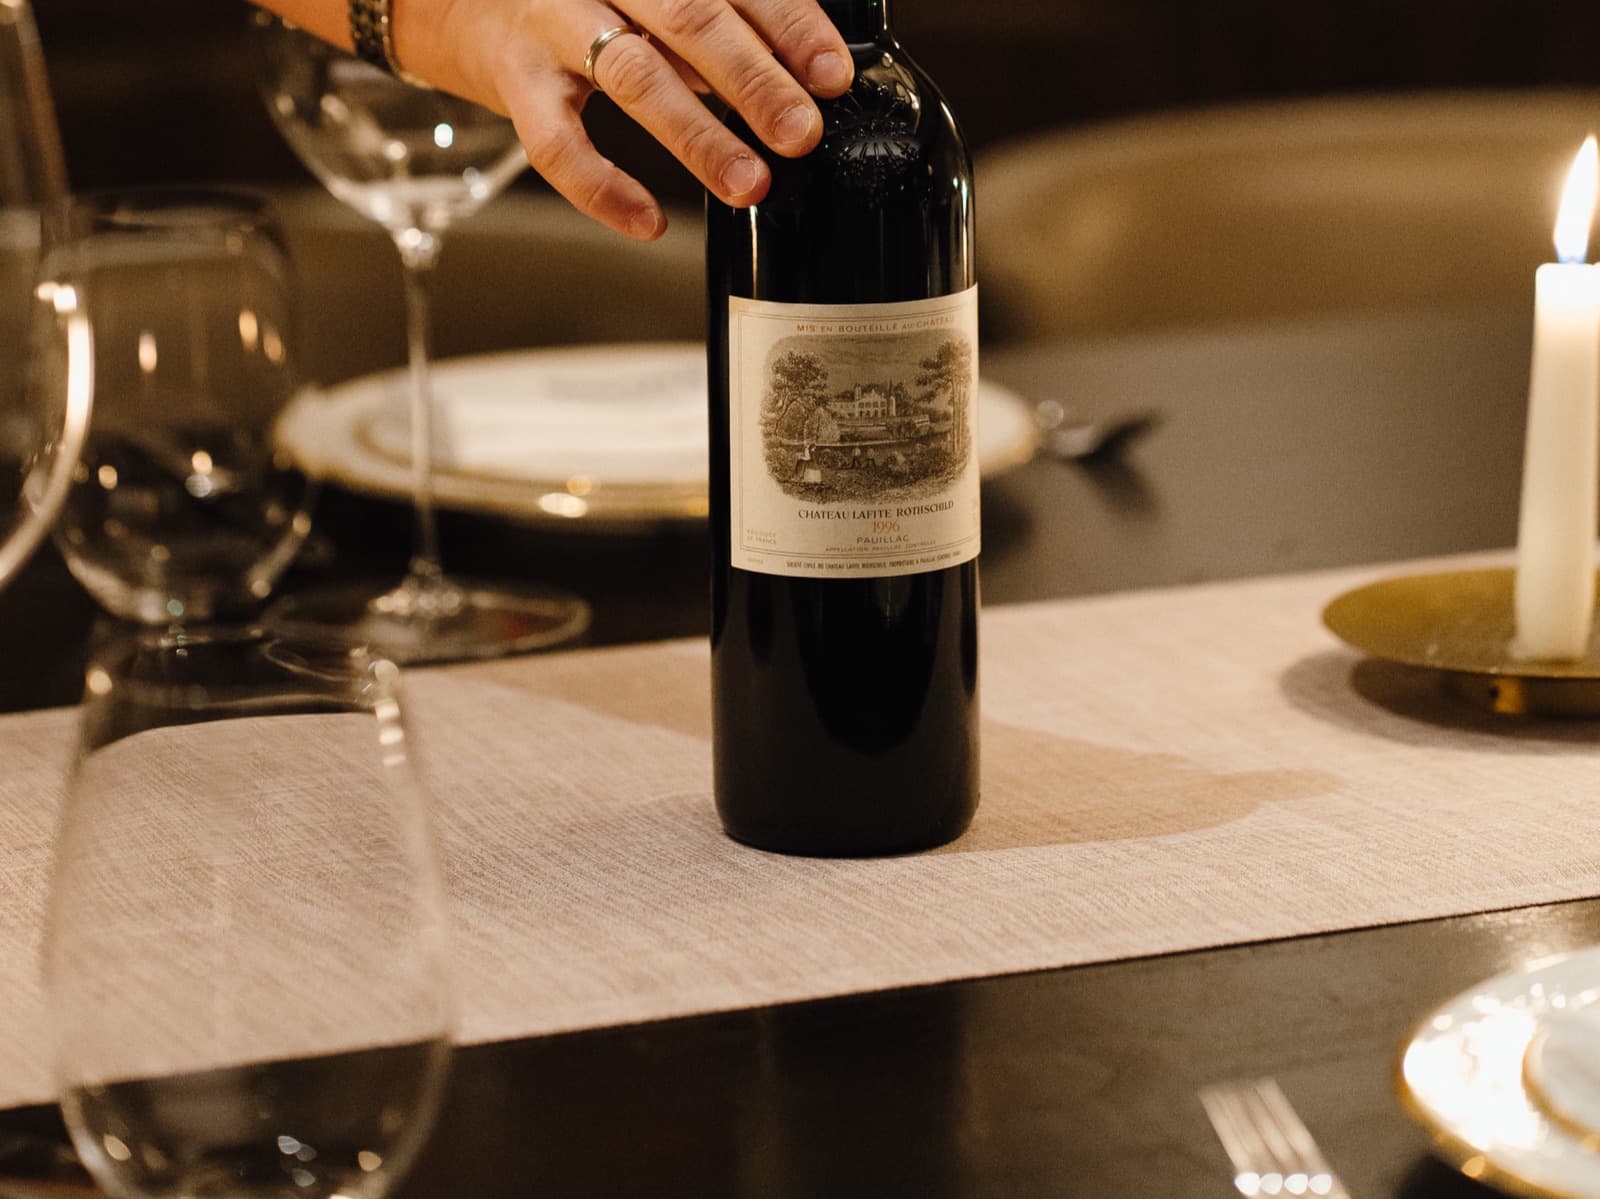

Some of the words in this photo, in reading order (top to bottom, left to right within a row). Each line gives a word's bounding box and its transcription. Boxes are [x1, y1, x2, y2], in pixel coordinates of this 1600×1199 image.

[797, 323, 816, 333] MIS
[838, 322, 898, 333] BOUTEILLE
[798, 509, 850, 520] CHATEAU
[852, 508, 892, 520] LAFITE
[896, 500, 954, 518] ROTHSCHILD
[872, 520, 900, 533] 1996
[856, 534, 910, 545] PAUILLAC
